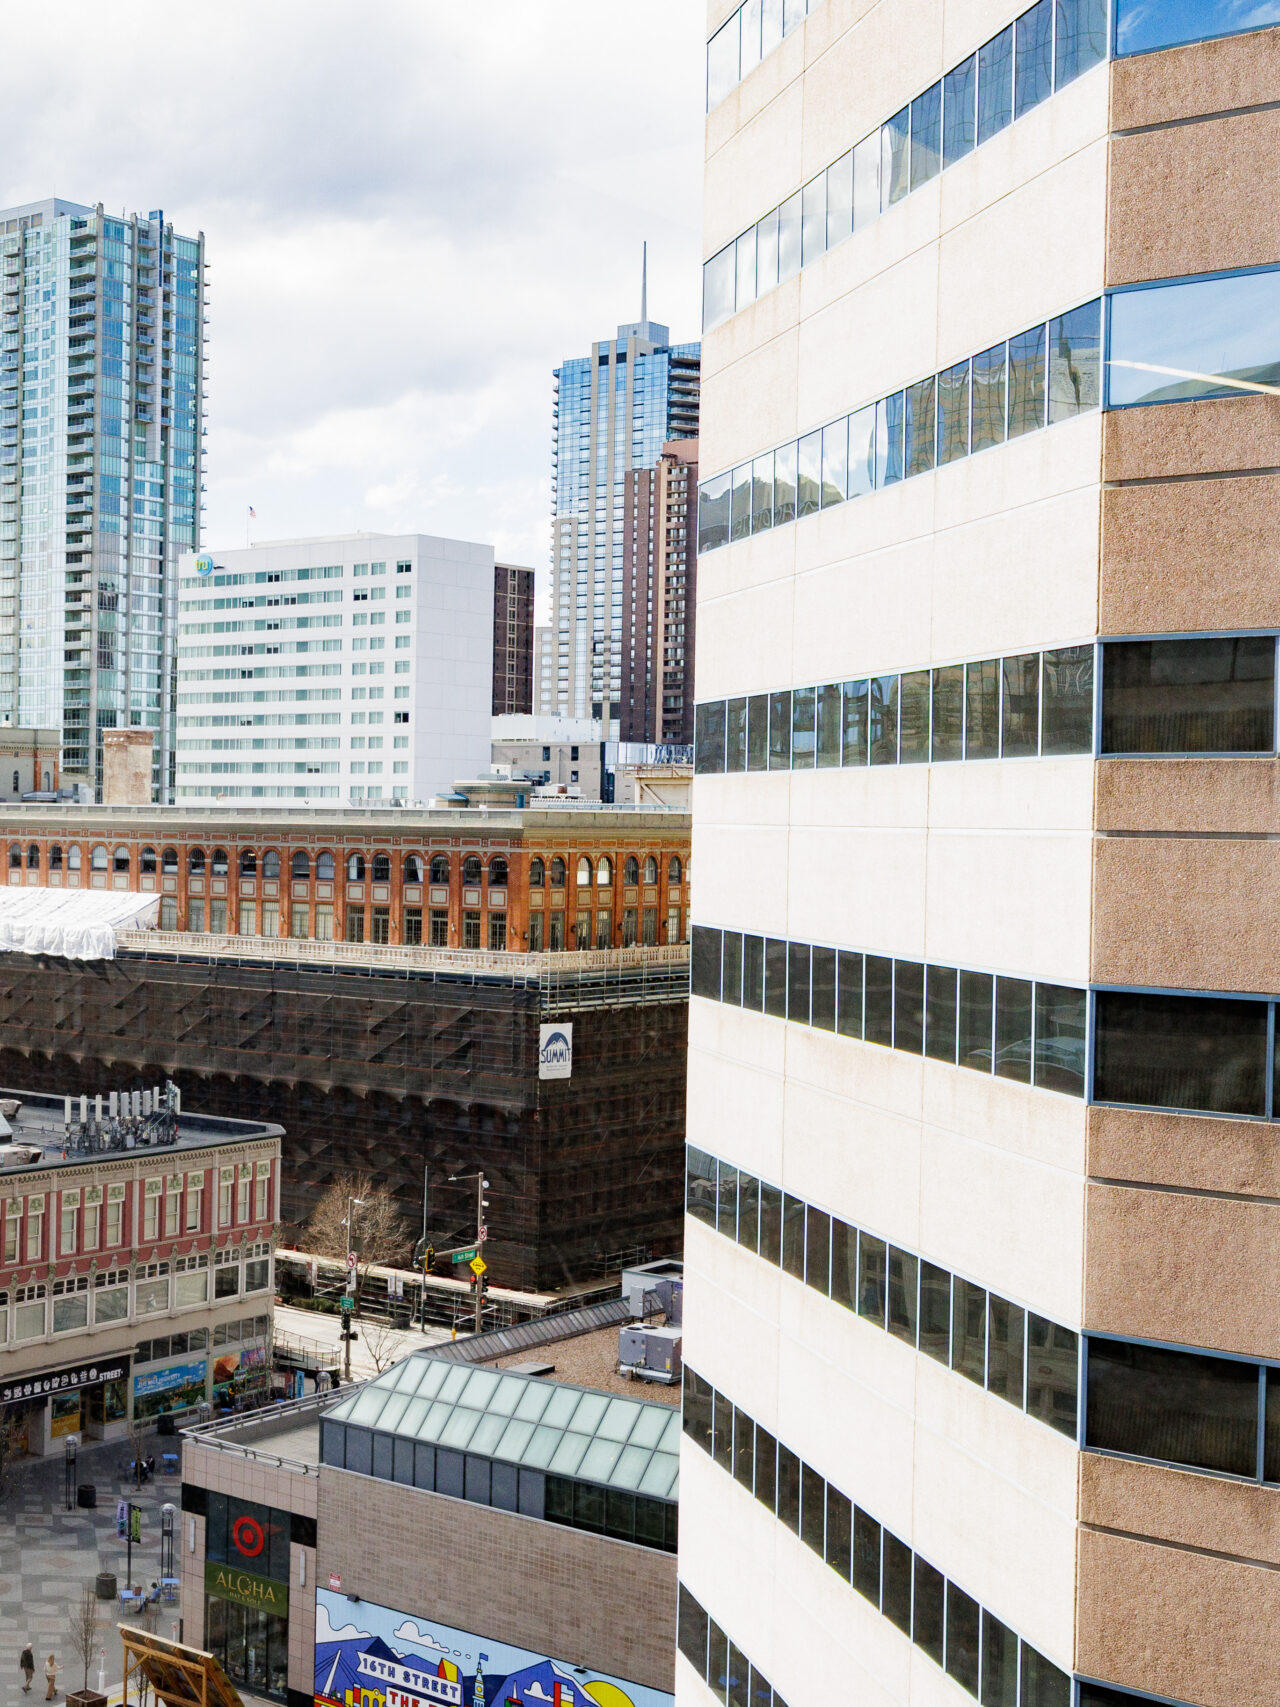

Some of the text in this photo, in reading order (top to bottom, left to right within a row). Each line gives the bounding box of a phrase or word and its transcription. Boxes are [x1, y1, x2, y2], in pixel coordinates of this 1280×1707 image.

[540, 1048, 571, 1063] SUMMIT
[99, 1369, 122, 1382] STREET
[216, 1571, 276, 1603] ALOHA
[363, 1657, 458, 1699] 16TH STREET
[389, 1690, 420, 1707] THE
